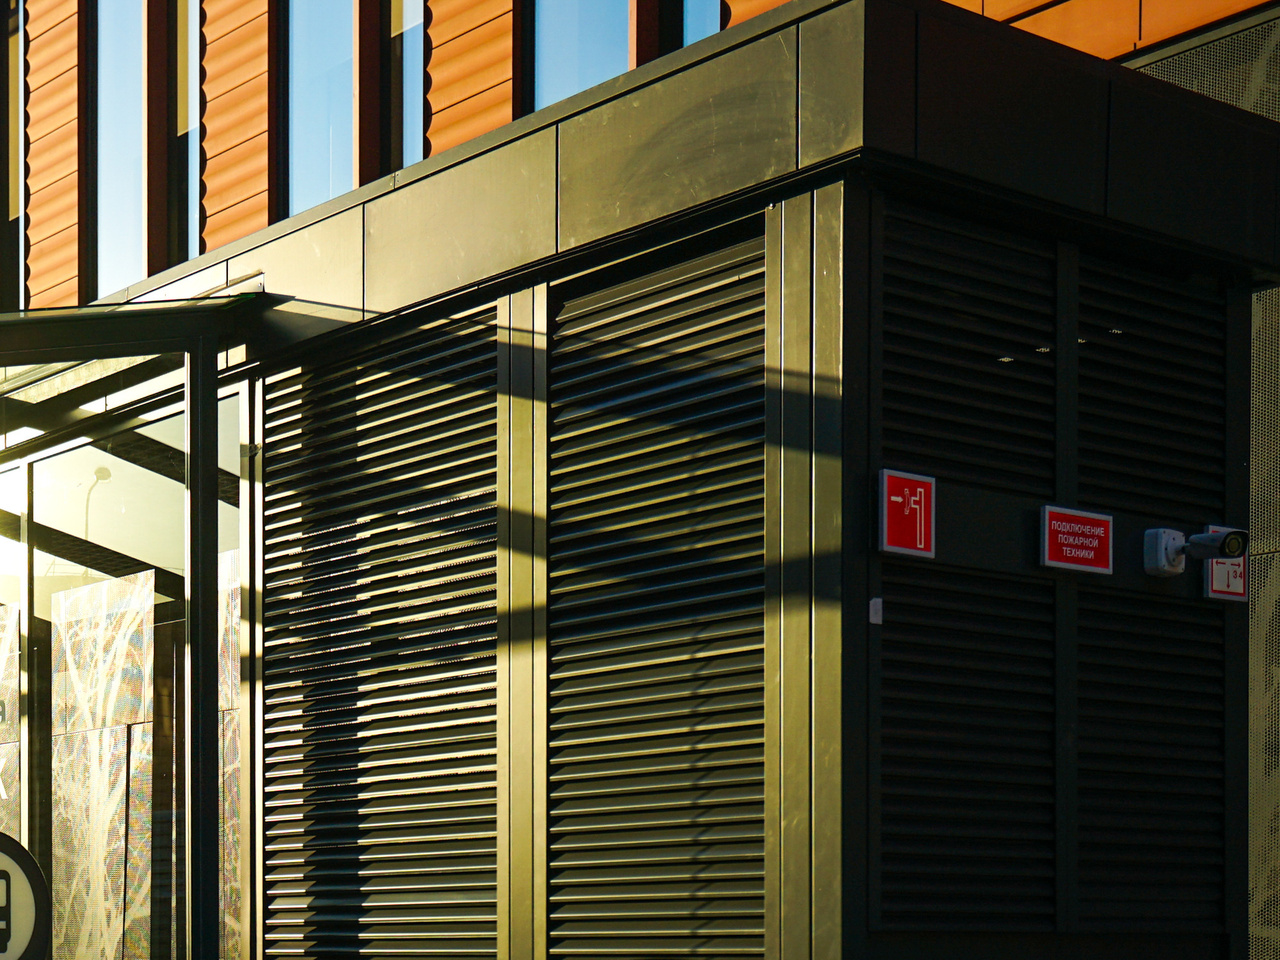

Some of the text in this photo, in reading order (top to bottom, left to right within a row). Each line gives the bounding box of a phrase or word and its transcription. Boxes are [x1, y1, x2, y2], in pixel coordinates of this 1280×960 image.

[1051, 521, 1105, 536] ПОДКЛЮЧЕНИЕ
[1058, 534, 1099, 548] ПОЖАРНОЙ
[1062, 547, 1094, 559] ТЕХНИКИ
